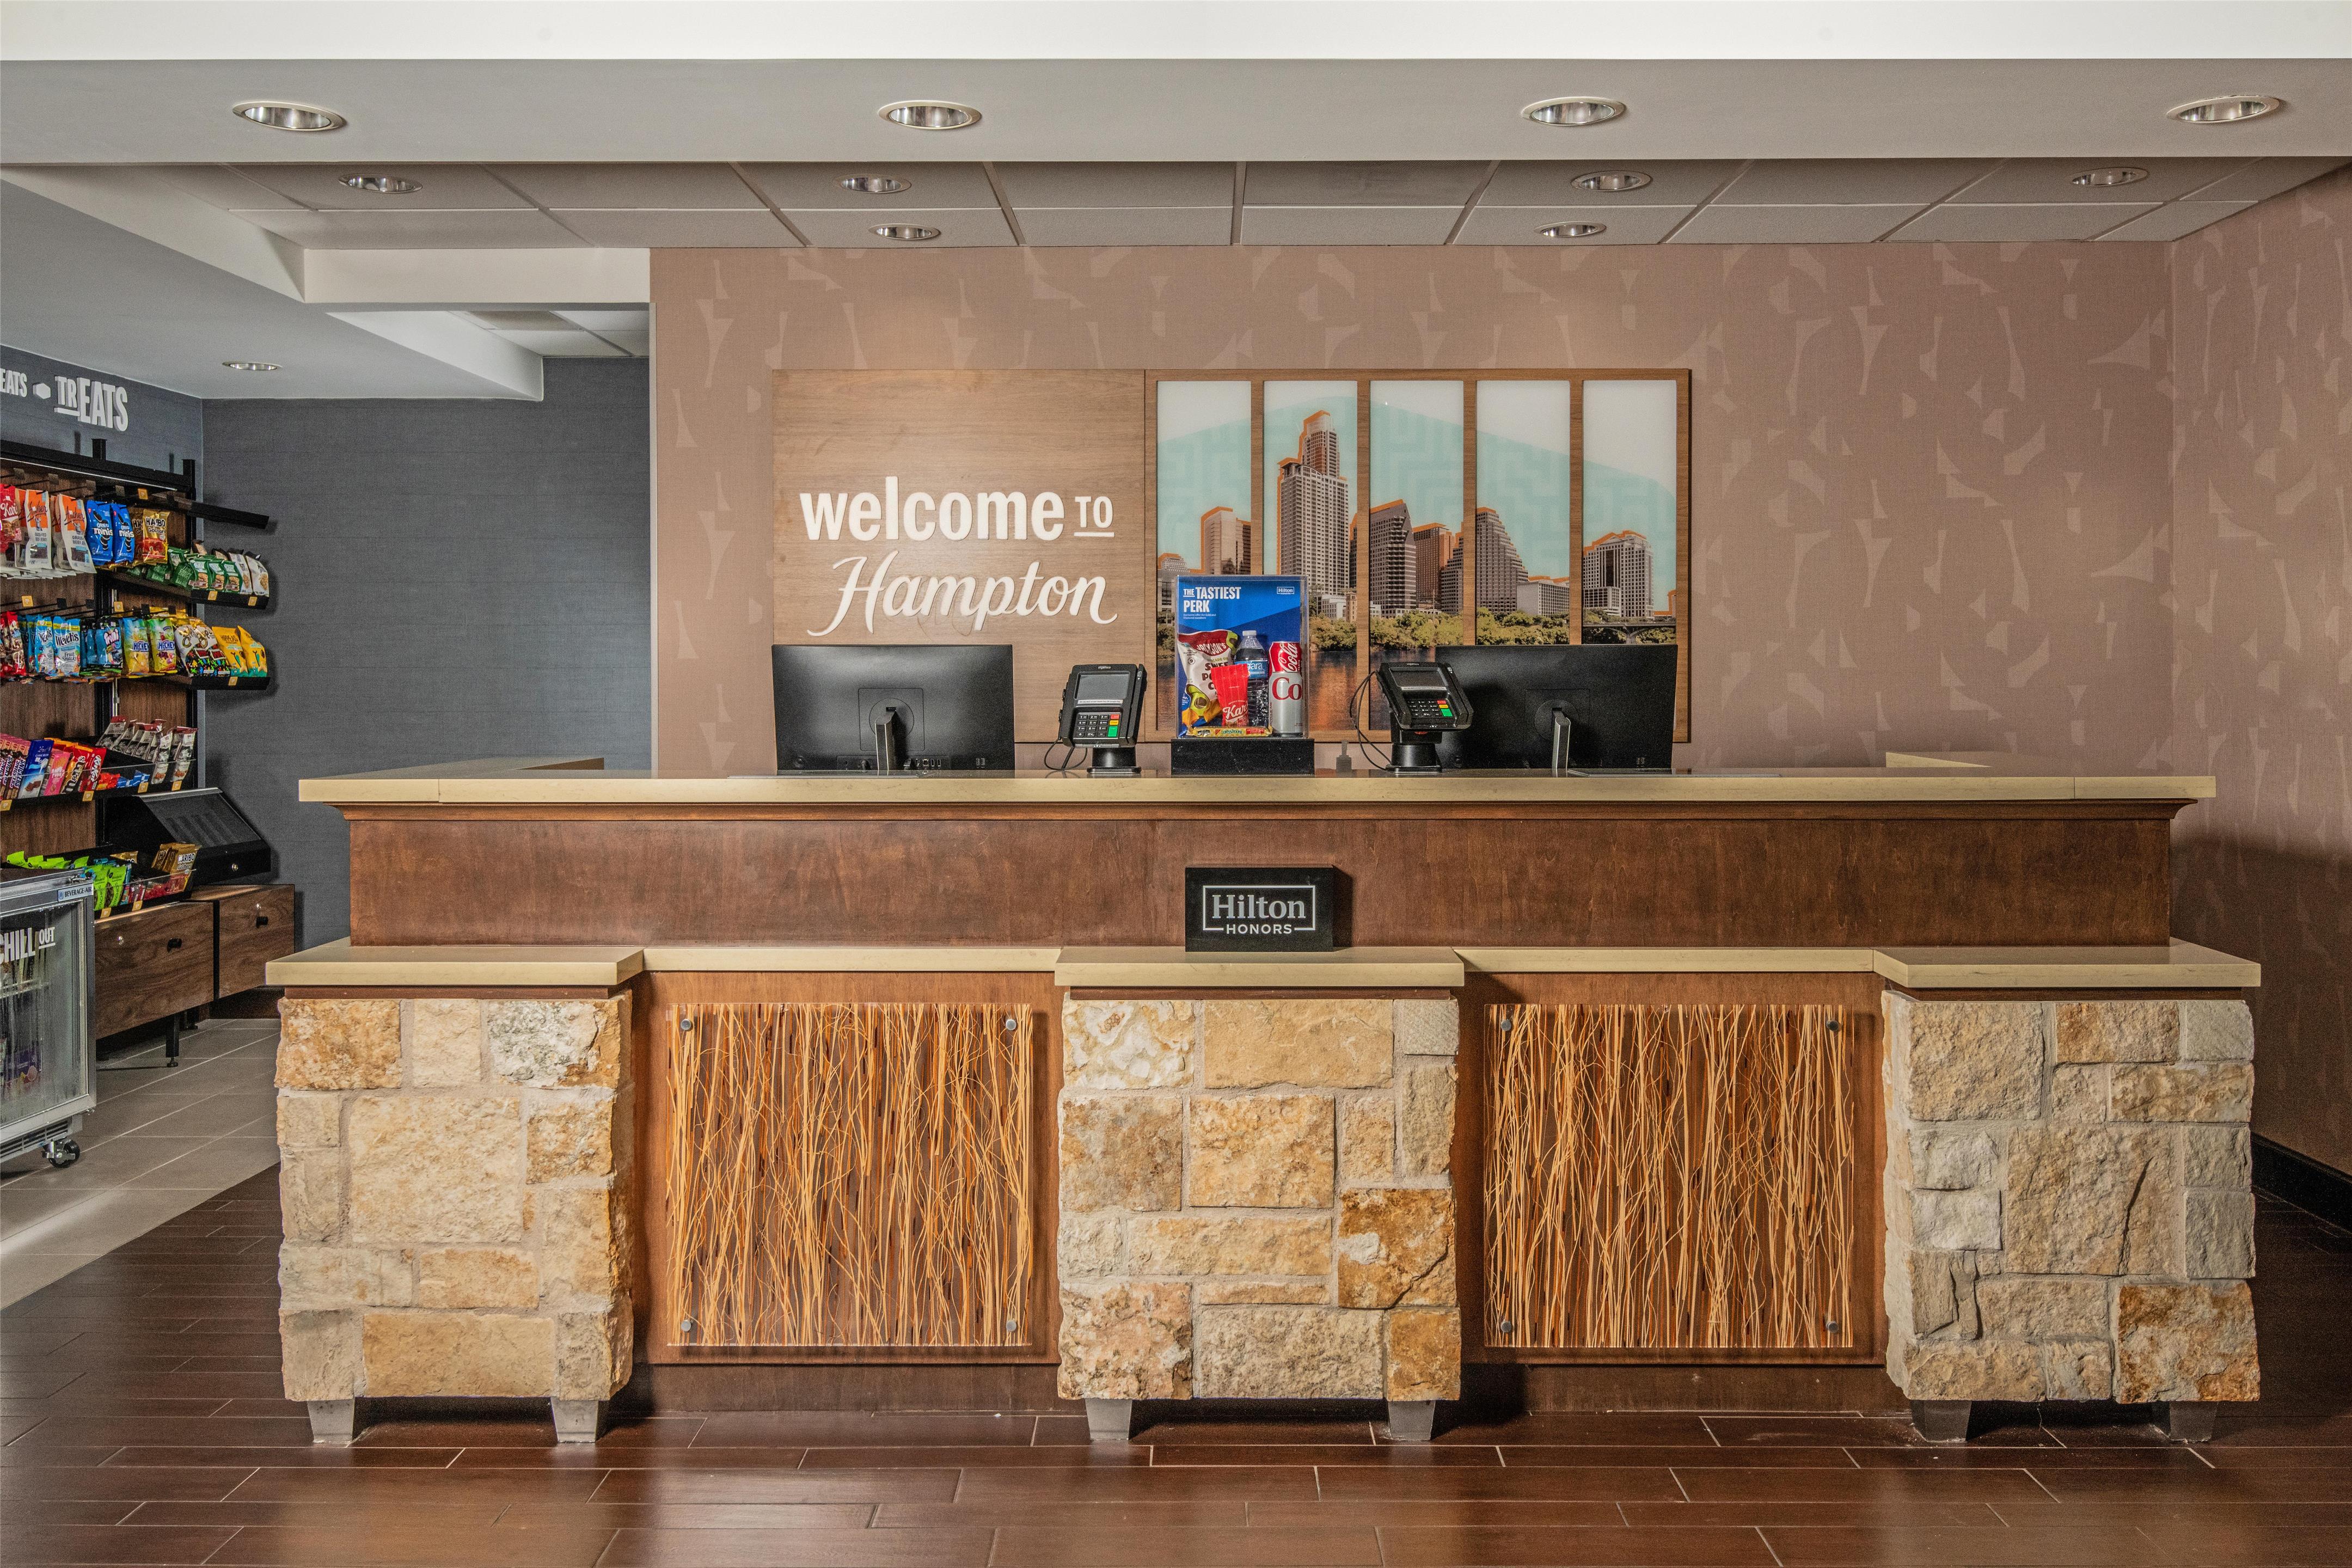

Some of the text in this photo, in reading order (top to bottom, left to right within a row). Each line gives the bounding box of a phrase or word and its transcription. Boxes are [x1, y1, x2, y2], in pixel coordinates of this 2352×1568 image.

[54, 376, 128, 431] TREATS
[799, 476, 1113, 541] welcome TO
[807, 550, 1118, 636] Hampton
[1195, 586, 1241, 599] TASTIEST
[1183, 600, 1210, 612] PERK
[1197, 642, 1227, 655] JACKSON'S
[178, 853, 195, 863] ARIBO
[64, 886, 92, 897] BEVERAGE-AIR
[1212, 895, 1306, 919] Hilton
[1226, 924, 1292, 934] HONORS
[0, 927, 55, 964] CHILL OUT
